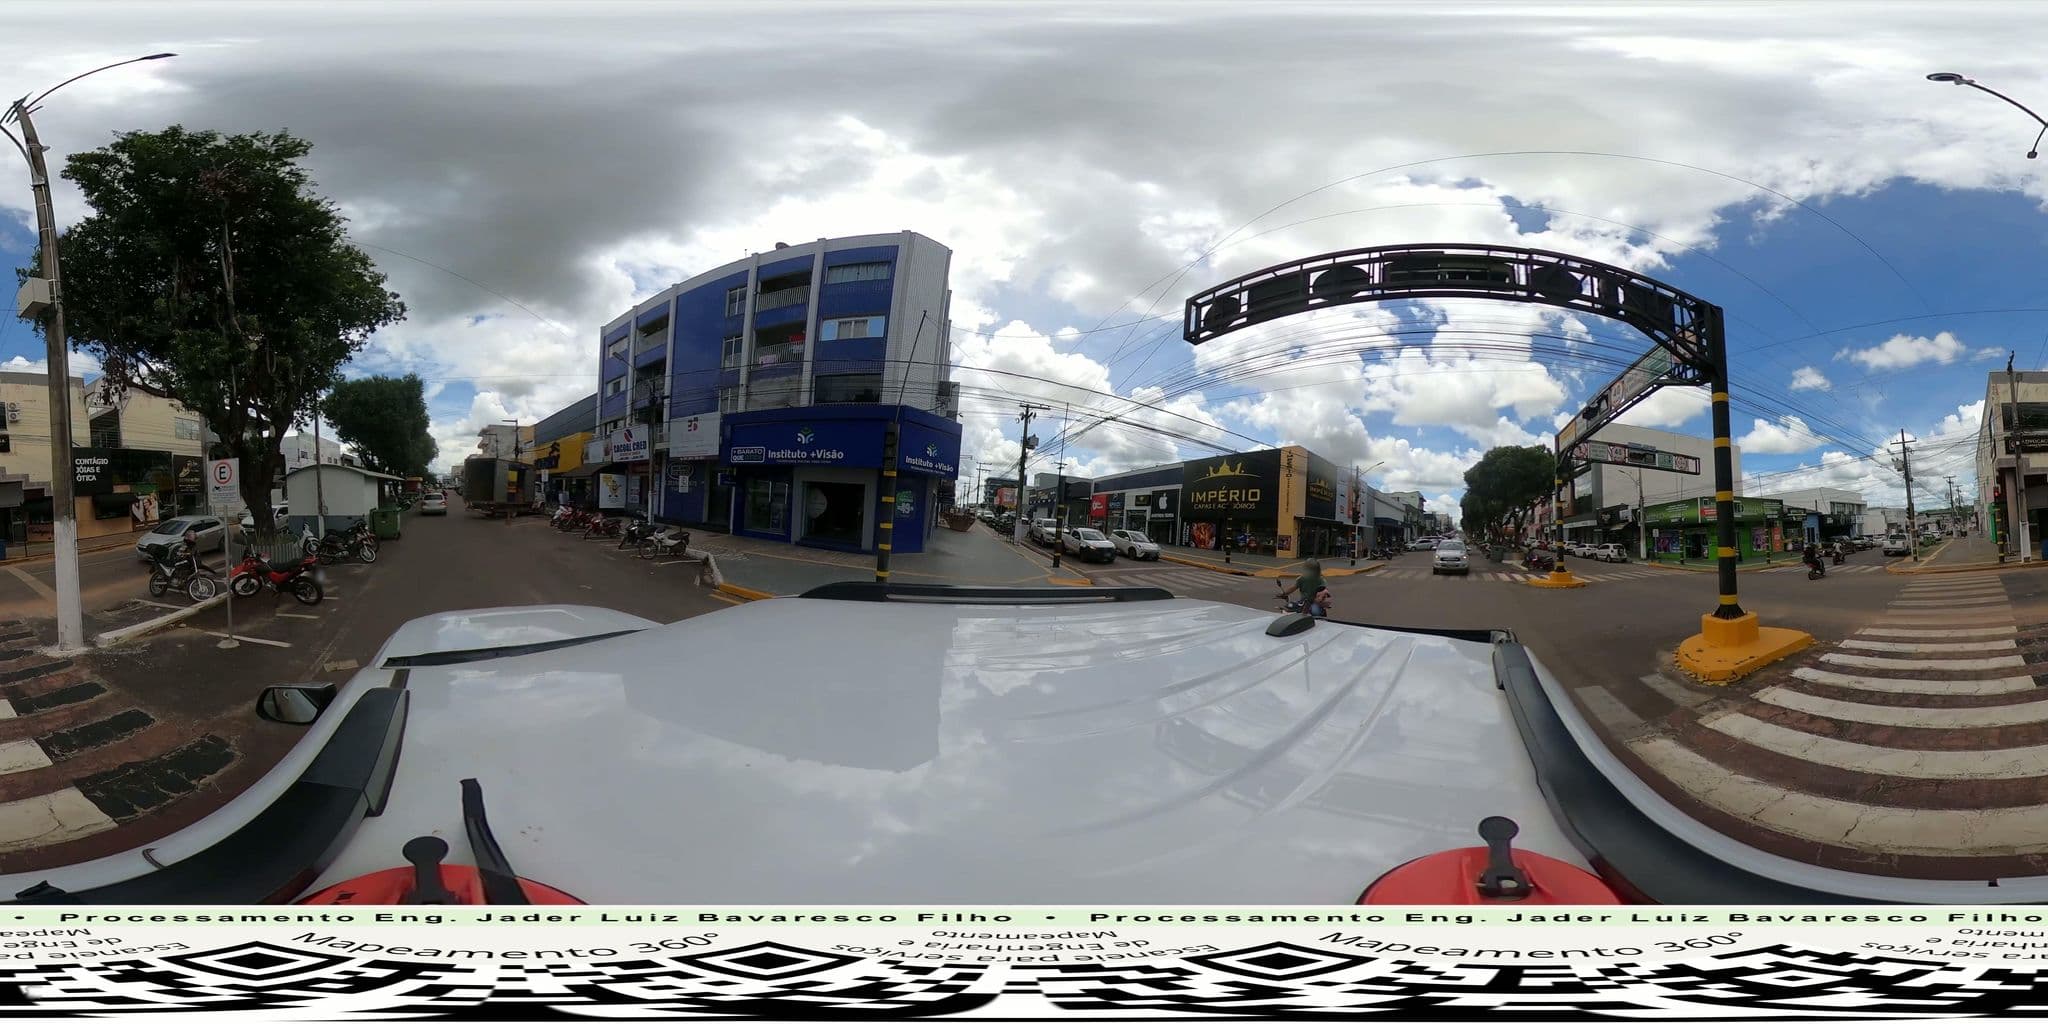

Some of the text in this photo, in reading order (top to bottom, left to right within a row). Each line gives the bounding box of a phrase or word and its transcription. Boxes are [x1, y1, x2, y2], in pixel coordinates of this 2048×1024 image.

[633, 440, 647, 451] CRED
[768, 449, 807, 459] Instituto
[810, 449, 844, 459] +Visão
[905, 455, 933, 468] Instituto
[219, 466, 227, 480] E
[1191, 485, 1261, 503] IMPÉRIO
